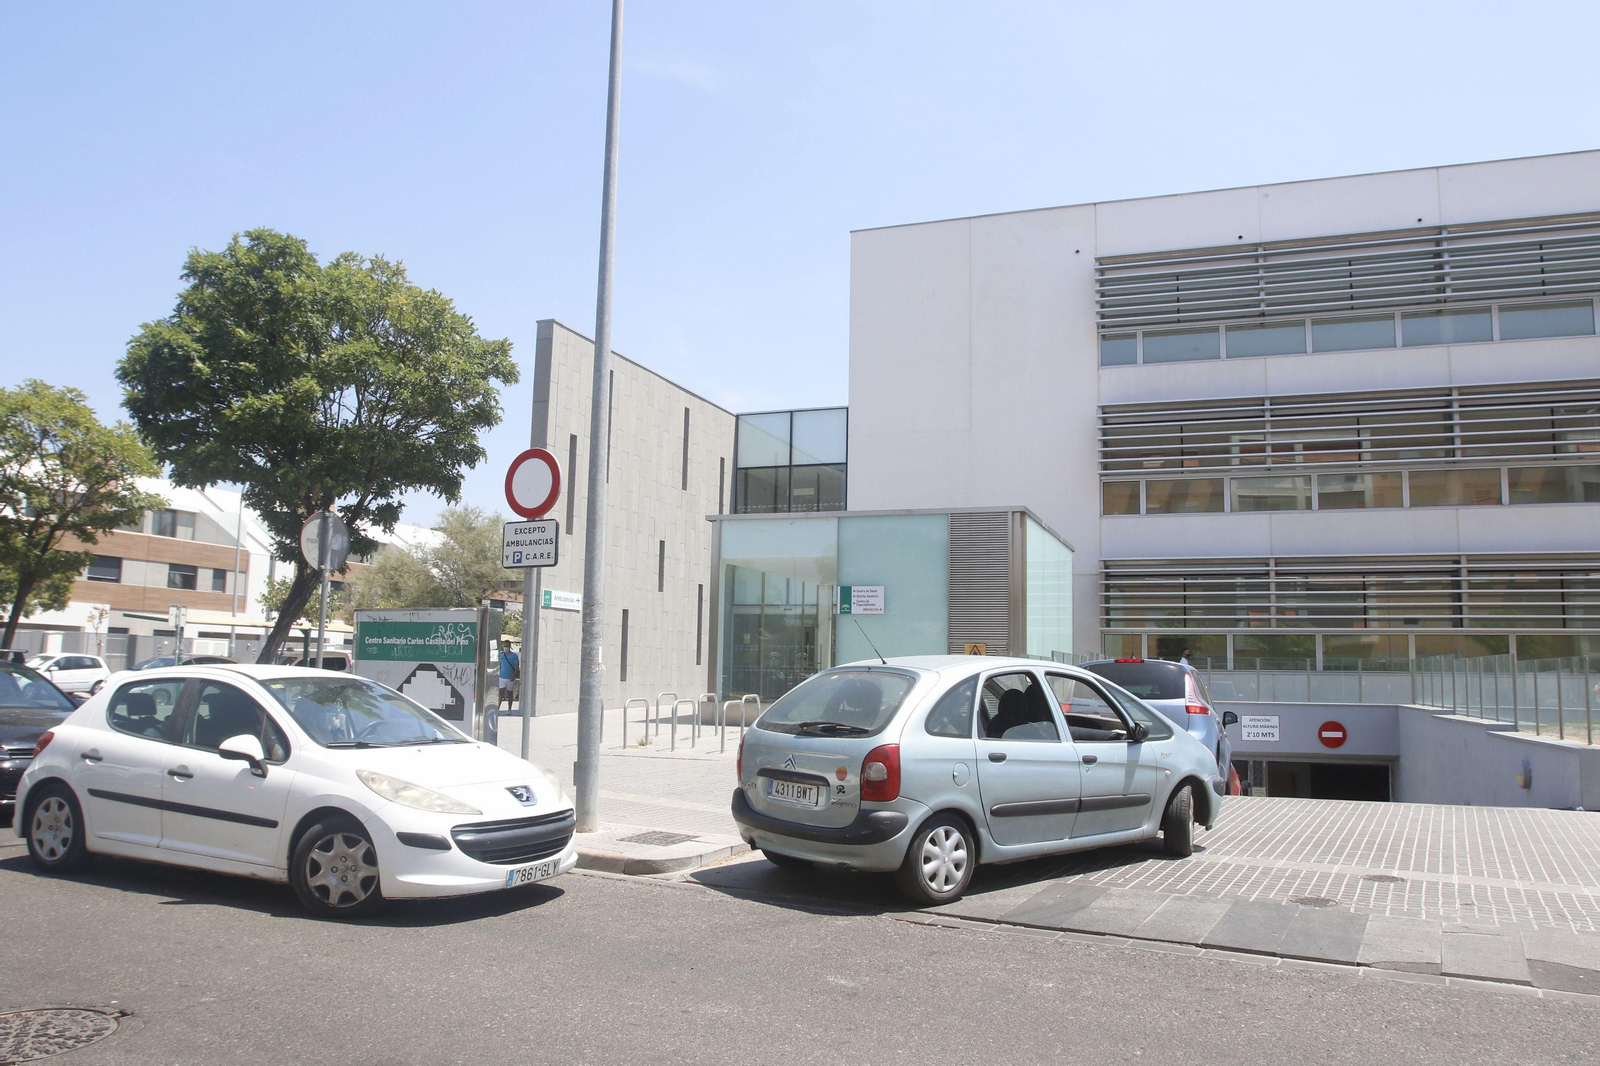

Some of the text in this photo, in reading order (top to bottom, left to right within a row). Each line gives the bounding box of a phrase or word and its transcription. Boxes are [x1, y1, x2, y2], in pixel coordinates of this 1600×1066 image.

[514, 526, 546, 535] EXCEPTO
[505, 538, 554, 547] AMBULANCIAS
[514, 552, 521, 563] P
[525, 552, 554, 560] C.A.R.E.
[365, 636, 382, 644] Centro
[383, 636, 406, 645] Sanitario
[407, 637, 424, 645] Carlos
[425, 637, 446, 646] Castilla
[447, 637, 455, 646] del
